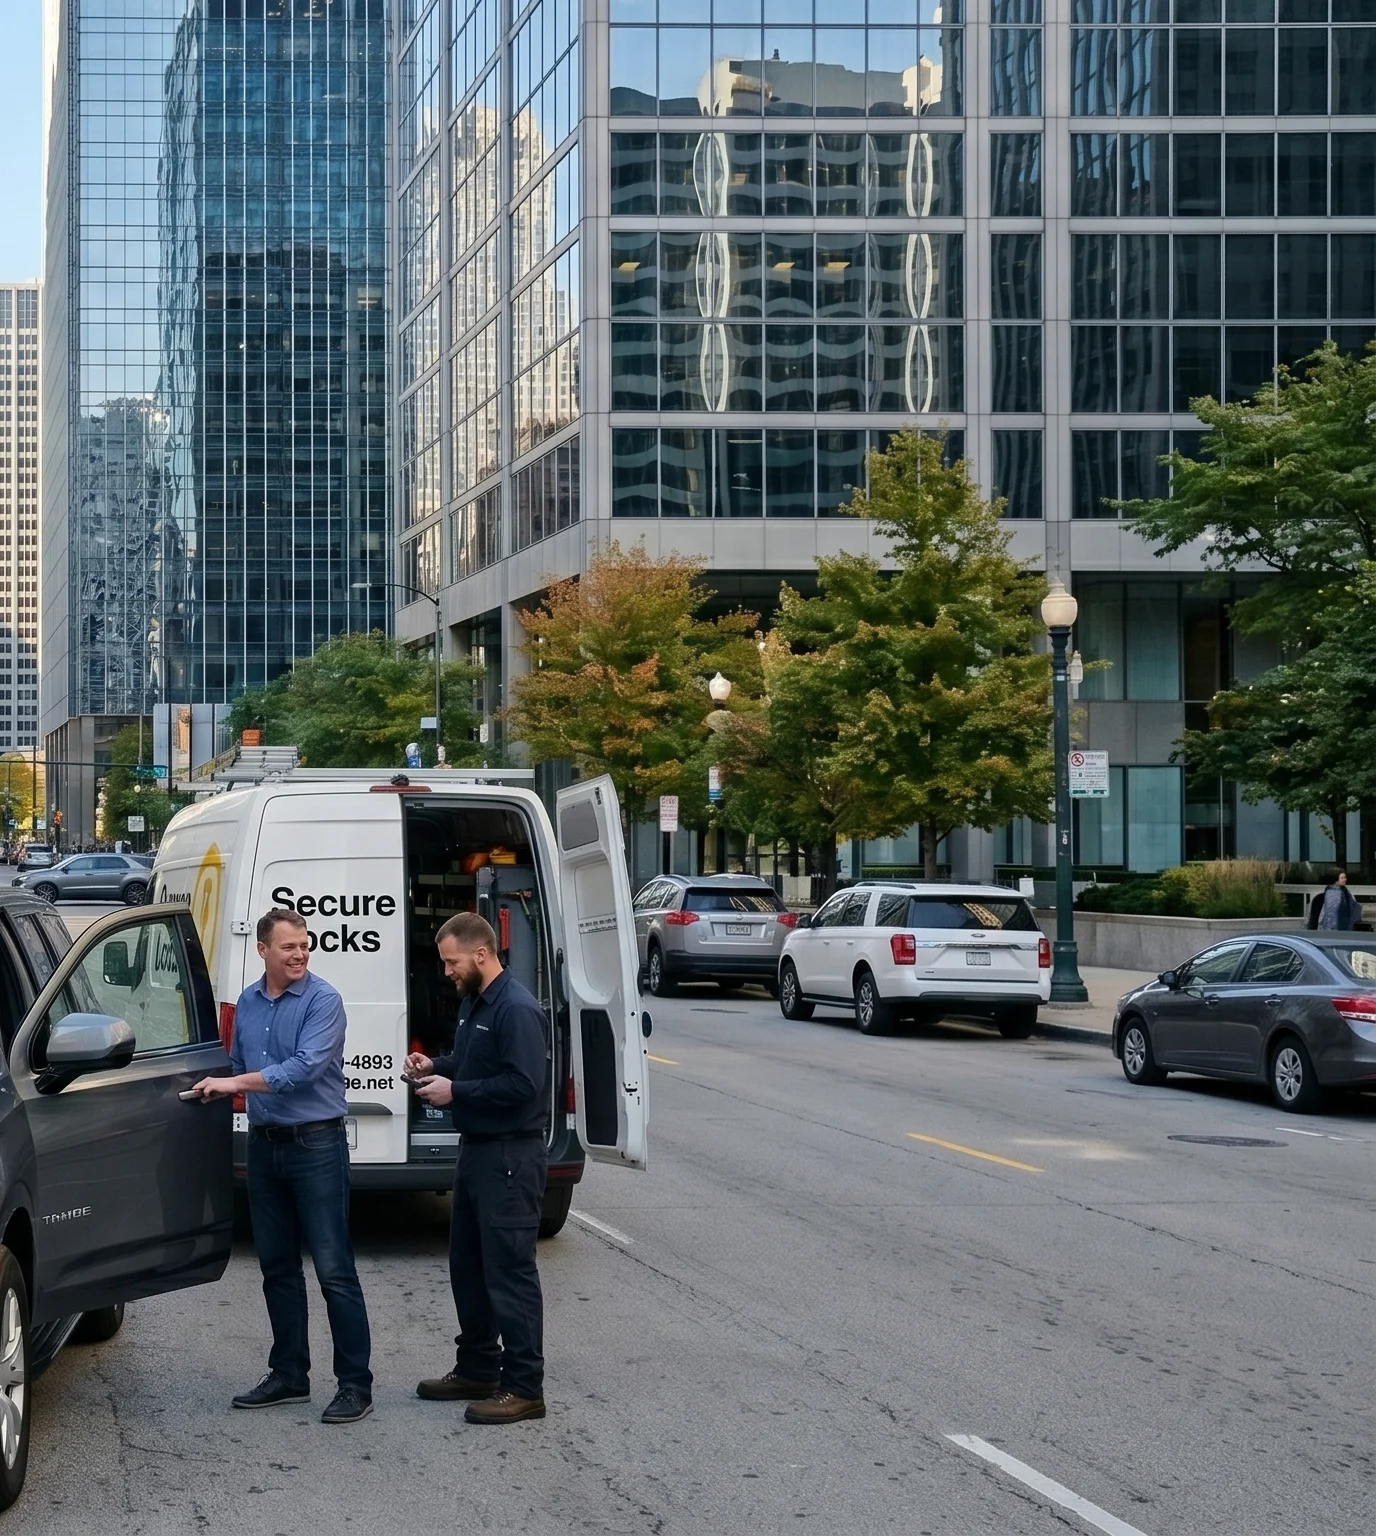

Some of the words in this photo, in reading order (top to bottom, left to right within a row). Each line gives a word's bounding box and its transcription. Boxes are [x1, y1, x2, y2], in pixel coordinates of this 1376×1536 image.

[271, 886, 396, 917] Secure
[307, 924, 381, 953] ocks
[341, 1055, 393, 1070] -4893
